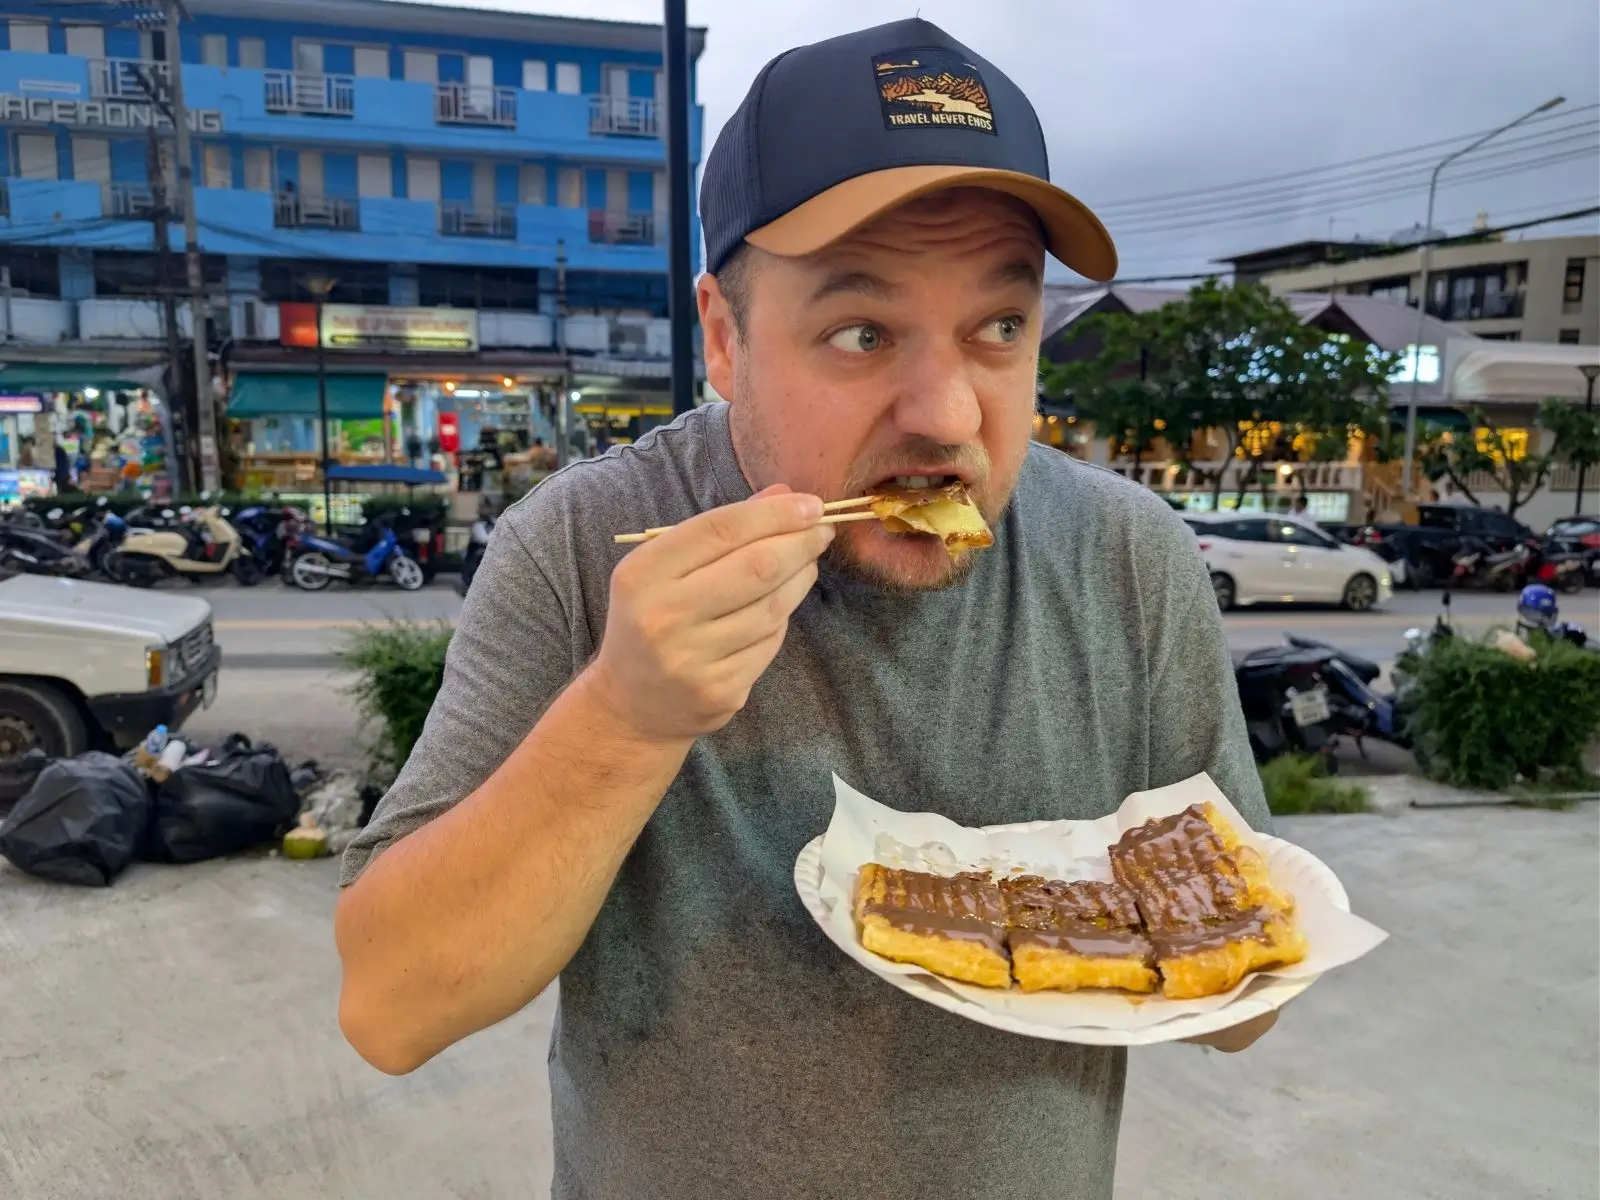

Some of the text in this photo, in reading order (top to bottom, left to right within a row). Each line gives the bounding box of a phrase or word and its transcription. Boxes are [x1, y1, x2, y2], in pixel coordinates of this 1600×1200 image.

[890, 113, 992, 130] TRAVEL NEVER ENDS
